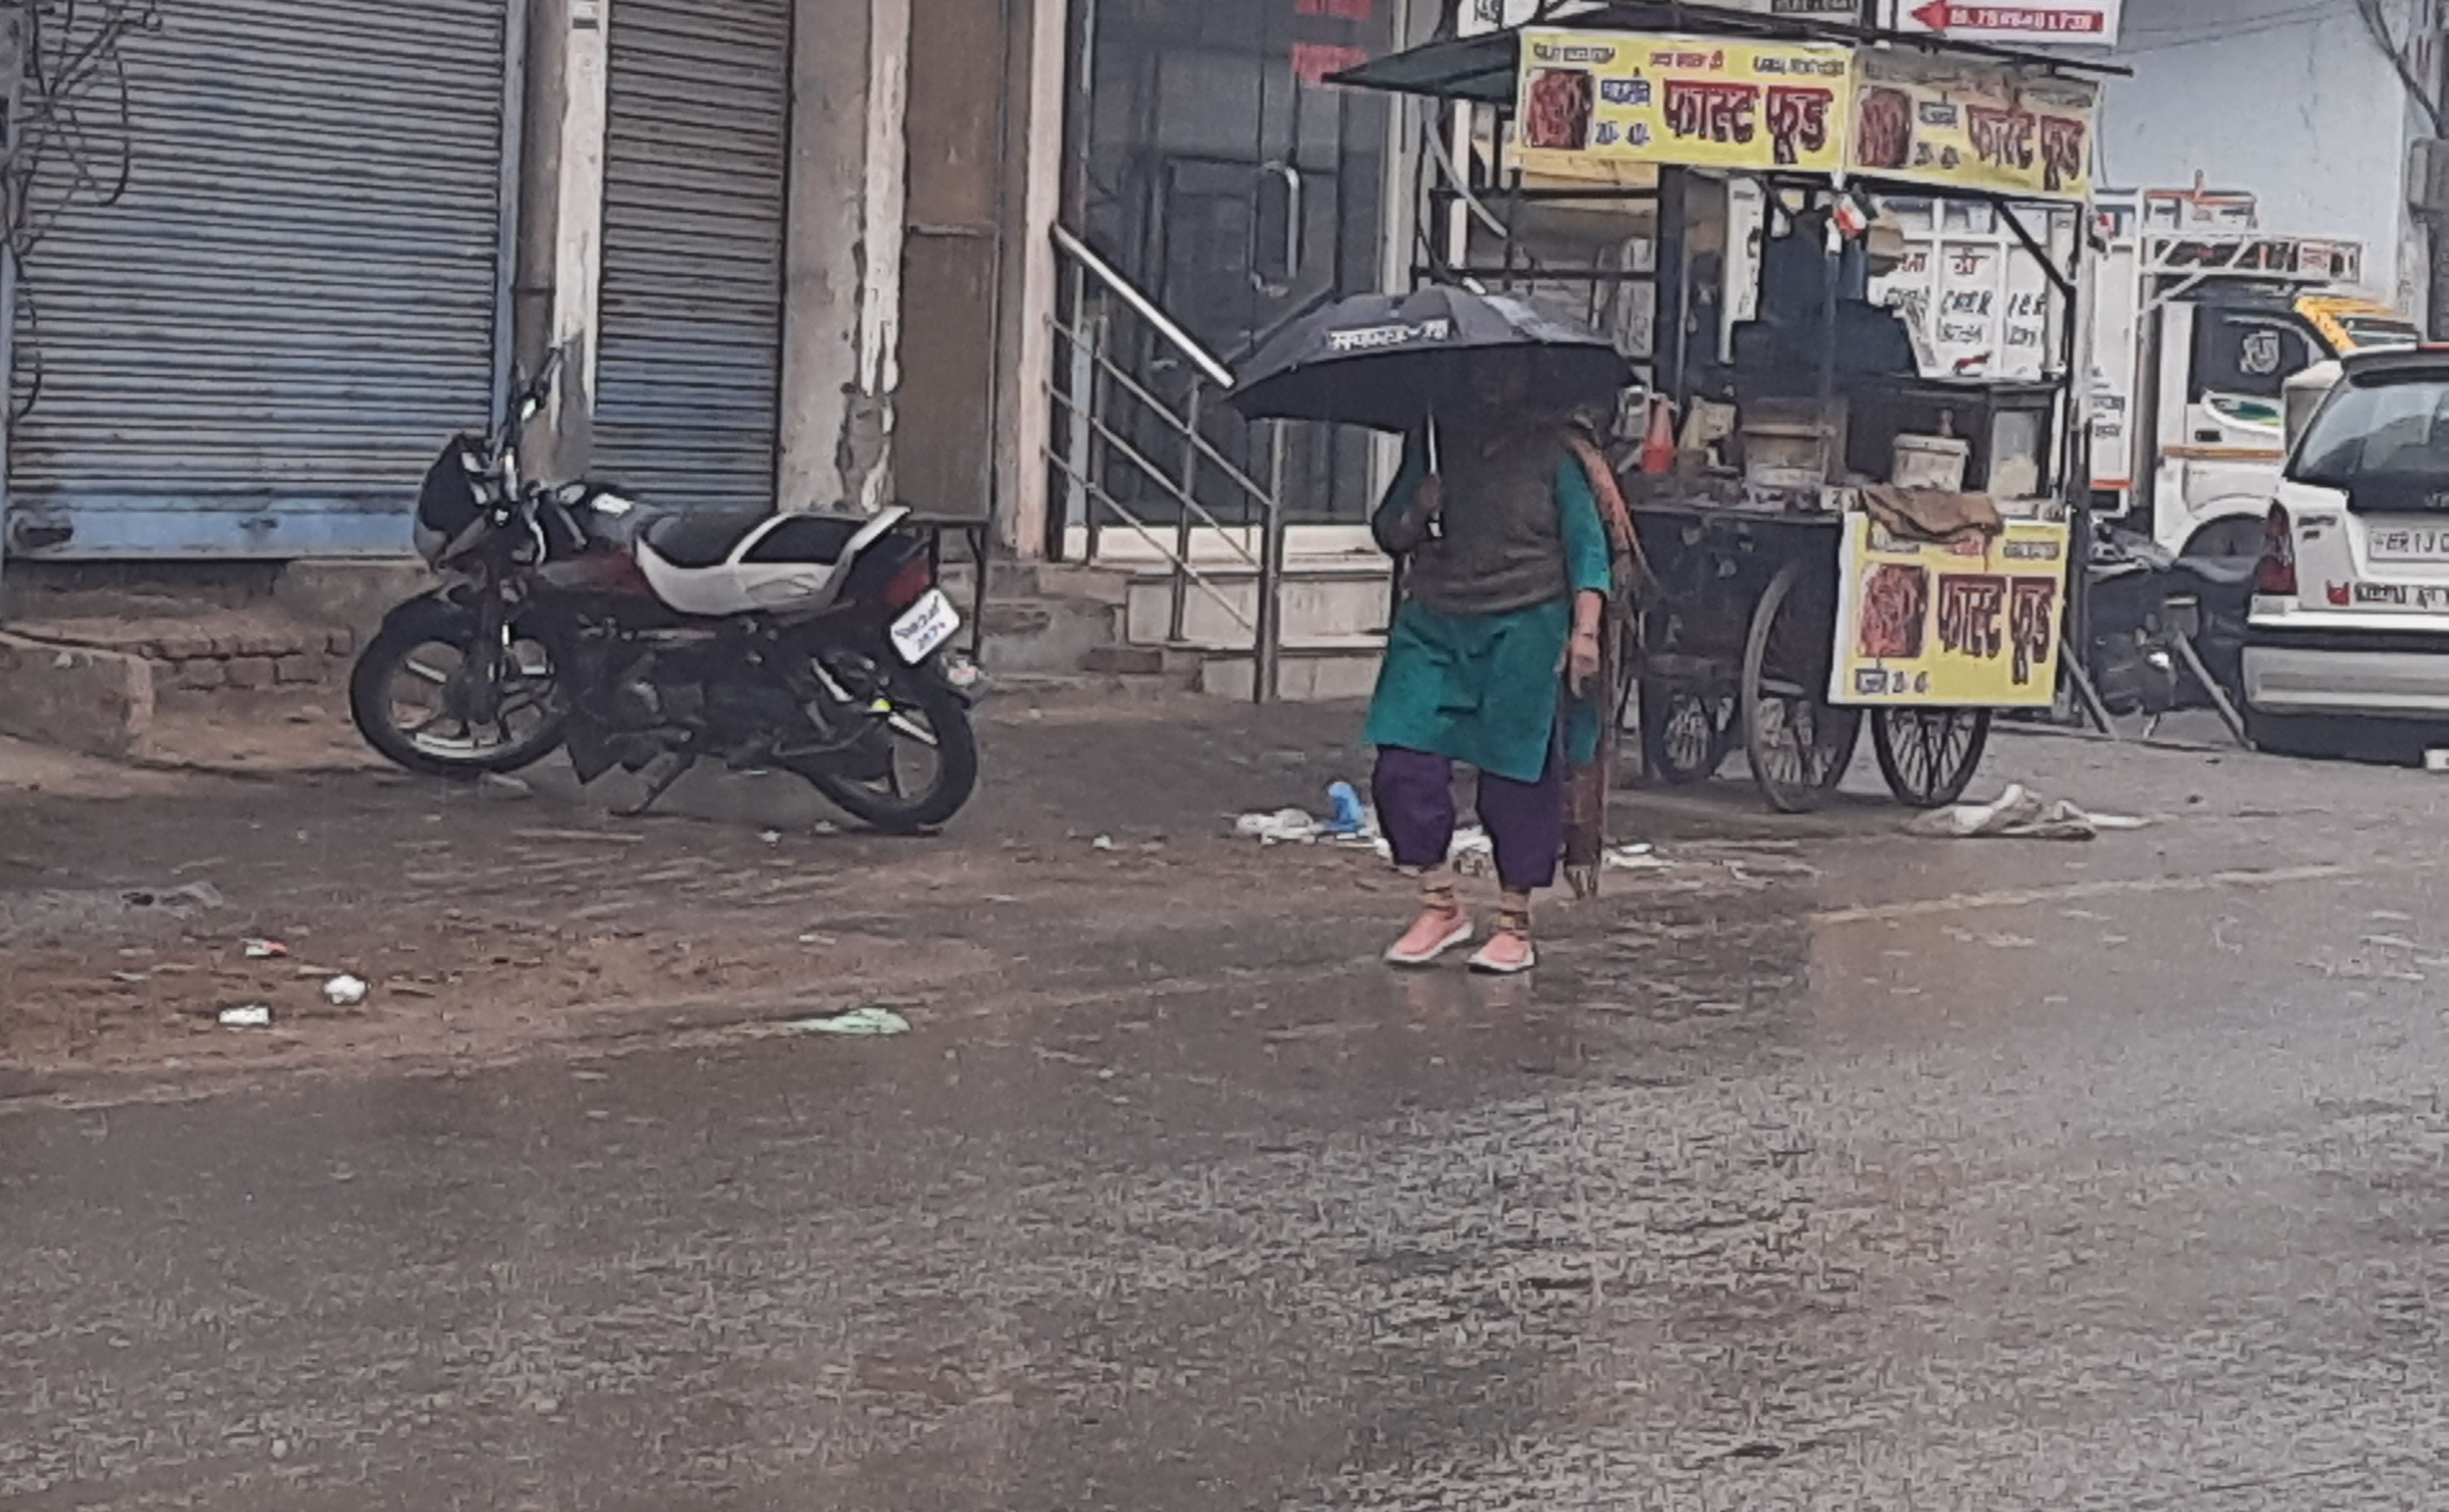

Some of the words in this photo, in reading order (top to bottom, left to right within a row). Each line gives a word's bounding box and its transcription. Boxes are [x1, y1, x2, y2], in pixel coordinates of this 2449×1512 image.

[1663, 78, 1760, 144] फास्ट
[1766, 85, 1835, 164] फूड
[1938, 574, 2006, 660] फास्ट
[2010, 577, 2057, 685] फूड
